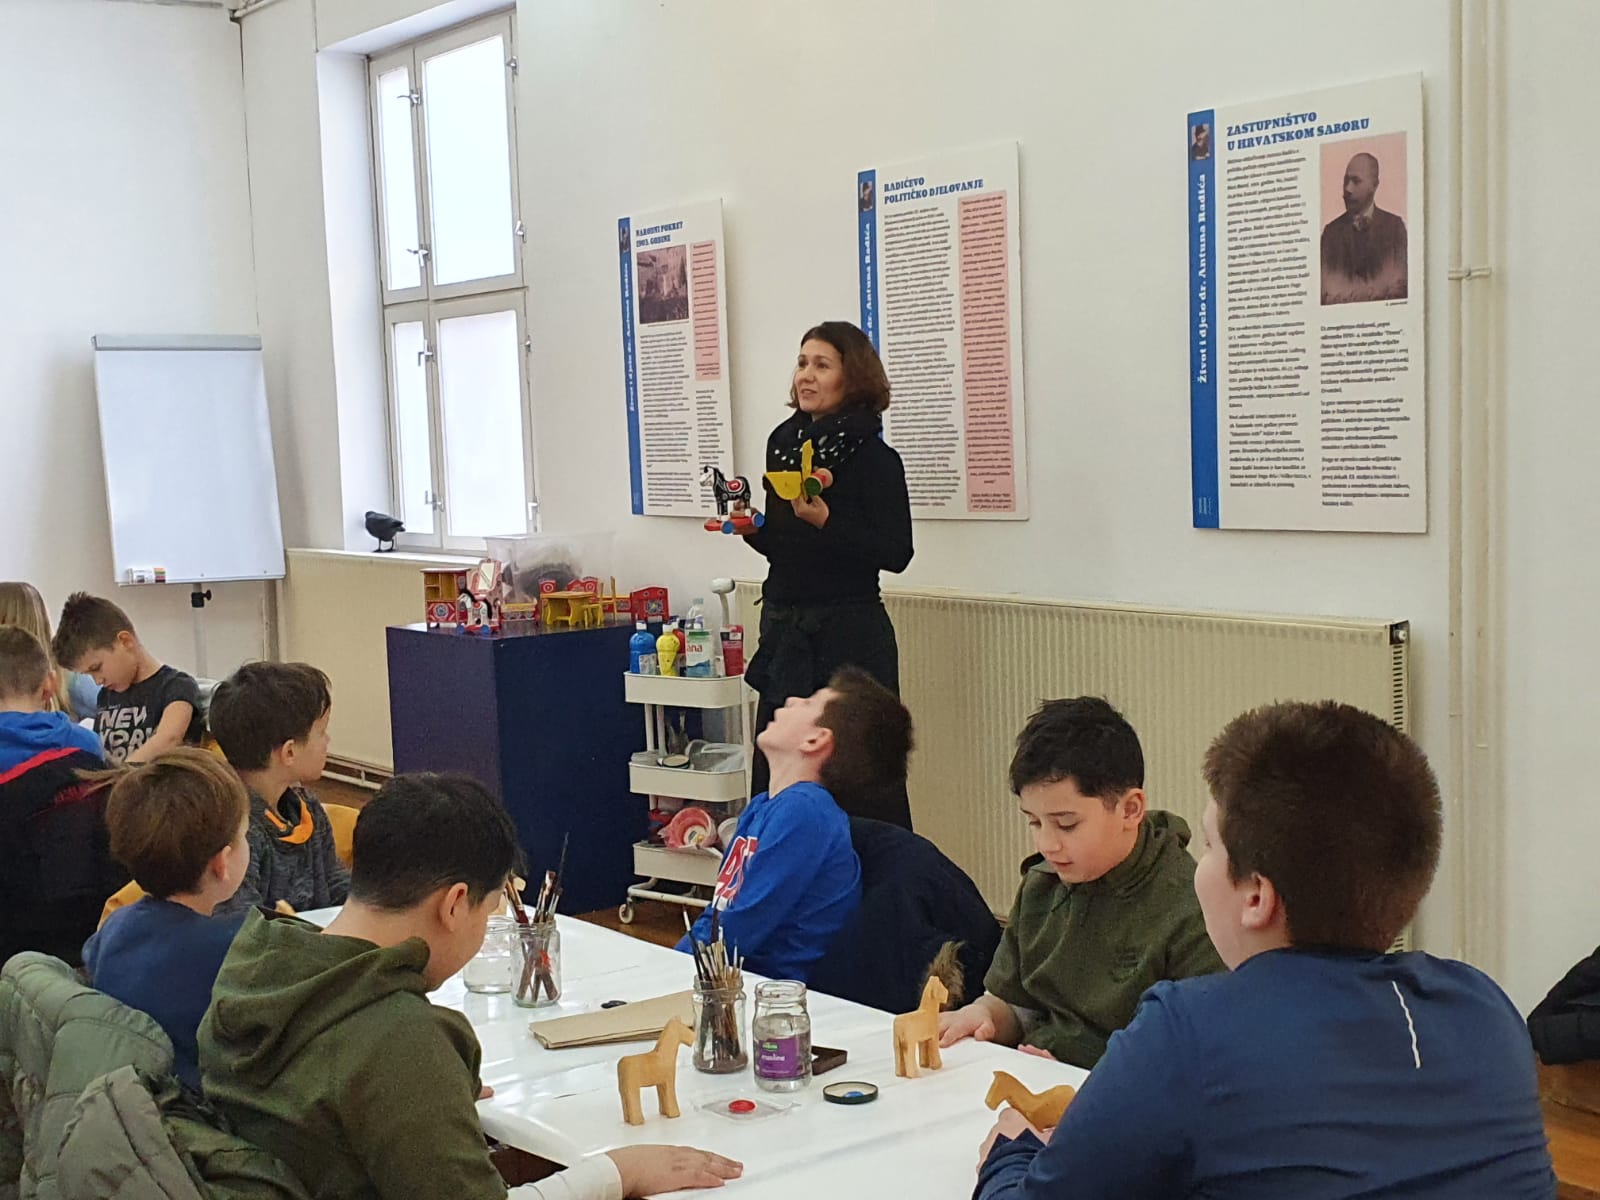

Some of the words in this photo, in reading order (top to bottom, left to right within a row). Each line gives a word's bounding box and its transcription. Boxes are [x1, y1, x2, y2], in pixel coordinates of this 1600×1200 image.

[1226, 111, 1318, 137] ZASTUPNIŠTVO
[1227, 140, 1235, 151] U
[1237, 127, 1315, 150] HRVATSKOM
[1316, 118, 1370, 137] SABORU
[884, 176, 925, 192] RADIĆEVO
[884, 189, 928, 205] POLITIČKO
[929, 179, 984, 197] DJELOVANJE
[1197, 174, 1206, 223] Radića
[1198, 224, 1207, 278] Antuna
[1198, 281, 1207, 298] dr.
[1199, 302, 1208, 338] djelo
[1197, 349, 1207, 384] Život
